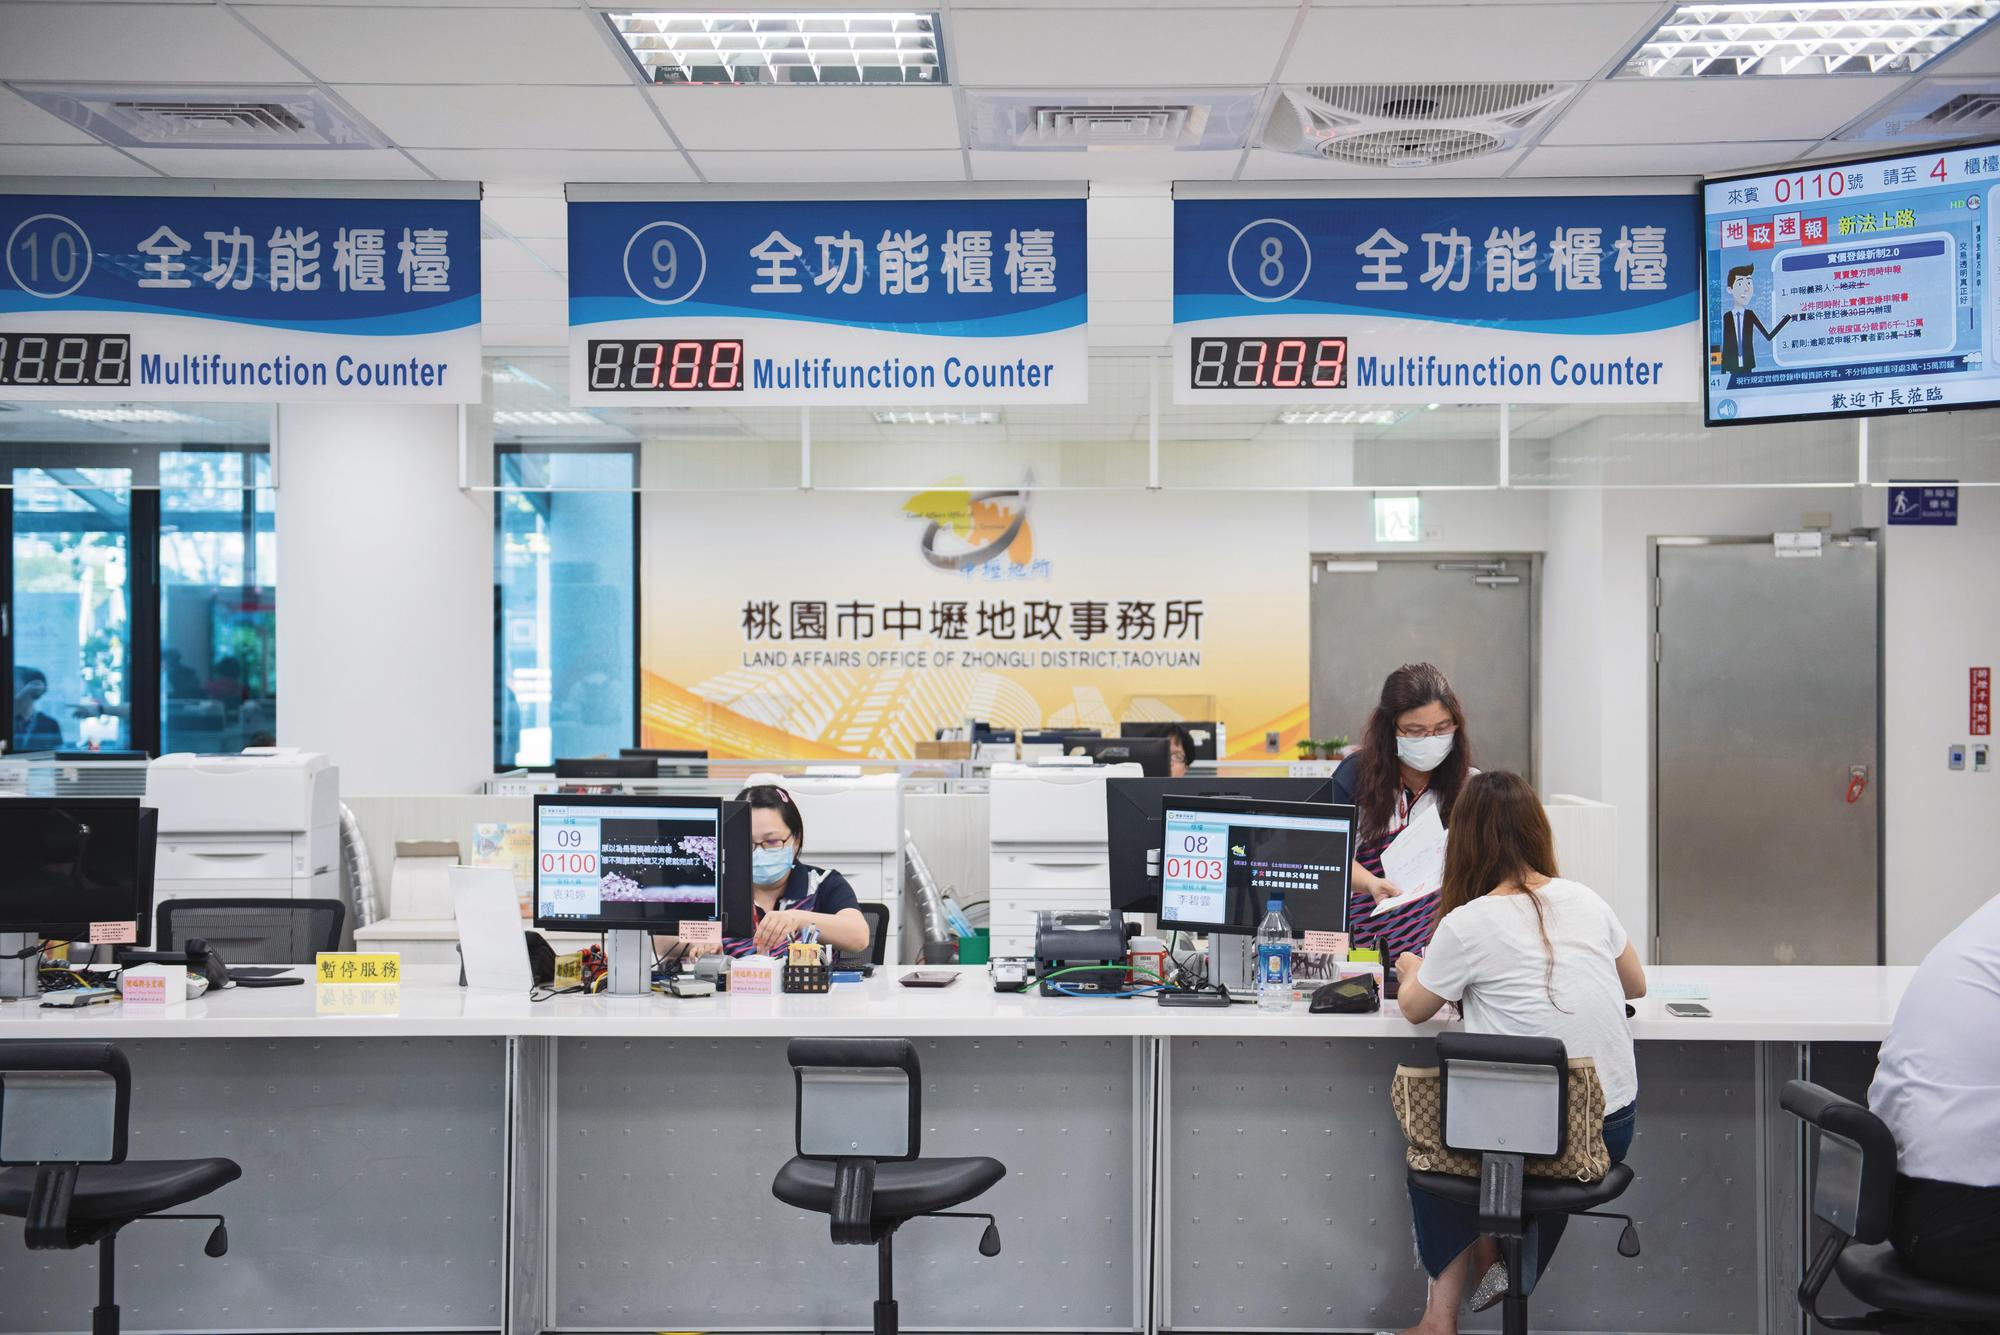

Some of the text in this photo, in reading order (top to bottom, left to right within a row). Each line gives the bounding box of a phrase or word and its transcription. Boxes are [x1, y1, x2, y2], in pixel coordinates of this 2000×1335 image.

[1727, 187, 1760, 206] 來賓
[1774, 171, 1845, 203] 0110
[1883, 166, 1918, 186] 請至
[1929, 157, 1947, 183] 4
[1950, 200, 1966, 209] HD
[1725, 216, 1825, 244] 地政速報
[1838, 207, 1916, 236] 新法上路
[20, 231, 77, 283] 10
[136, 224, 452, 294] 全功能櫃檯
[651, 238, 678, 290] 9
[749, 228, 1058, 296] 全功能櫃檯
[1258, 236, 1285, 288] 8
[1354, 225, 1669, 293] 全功能櫃檯
[1782, 341, 1790, 349] 3.
[140, 353, 328, 388] Multifunction
[335, 354, 448, 387] Counter
[752, 357, 1055, 390] Multifunction Counter
[1356, 354, 1664, 388] Multifunction Counter
[1710, 379, 1721, 387] 41
[1830, 385, 1945, 411] 歡迎市長蒞臨
[741, 599, 1205, 642] 桃園市中壢地政事務所
[743, 650, 787, 668] LAND
[792, 650, 862, 668] AFFAIRS
[866, 650, 928, 668] OFFICE
[932, 650, 956, 668] OF
[961, 650, 1036, 668] ZHONGLI
[557, 830, 582, 848] 09
[1184, 835, 1209, 854] 08
[541, 853, 596, 874] 0100
[1167, 858, 1223, 881] 0103
[319, 959, 399, 980] 暫停服務
